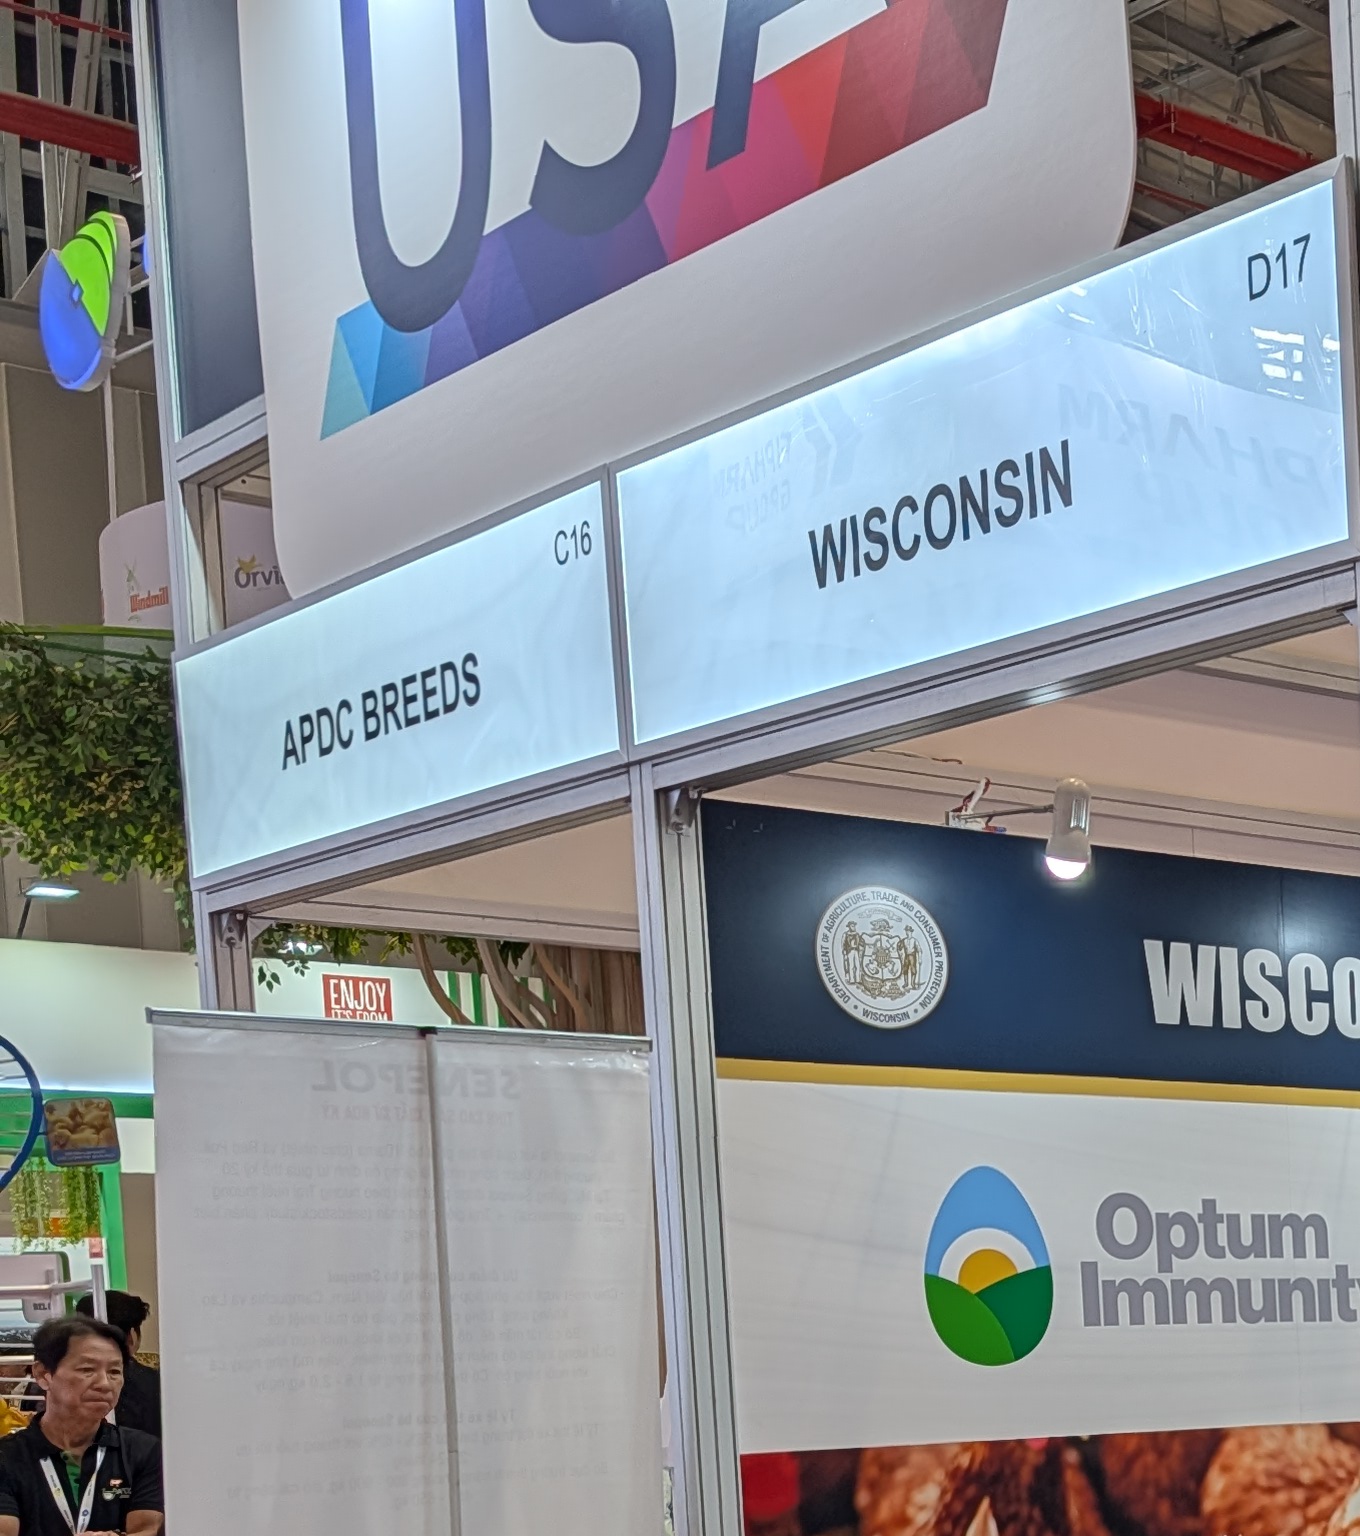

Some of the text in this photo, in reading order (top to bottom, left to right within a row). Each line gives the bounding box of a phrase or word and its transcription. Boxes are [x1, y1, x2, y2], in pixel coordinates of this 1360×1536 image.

[1246, 232, 1312, 304] D17
[808, 440, 1074, 590] WISCONSIN
[553, 520, 592, 567] C16
[282, 652, 482, 770] APDC BREEDS
[823, 891, 871, 933] AGRICULTURE,
[871, 890, 899, 903] TRADE
[900, 899, 915, 912] AND
[913, 910, 943, 958] CONSUMER
[329, 978, 387, 1012] ENJOY
[820, 945, 850, 1005] DEPARTMENT
[919, 960, 944, 1010] PROTECTION
[862, 1007, 911, 1023] WISCONSIN
[1096, 1192, 1329, 1272] Optum
